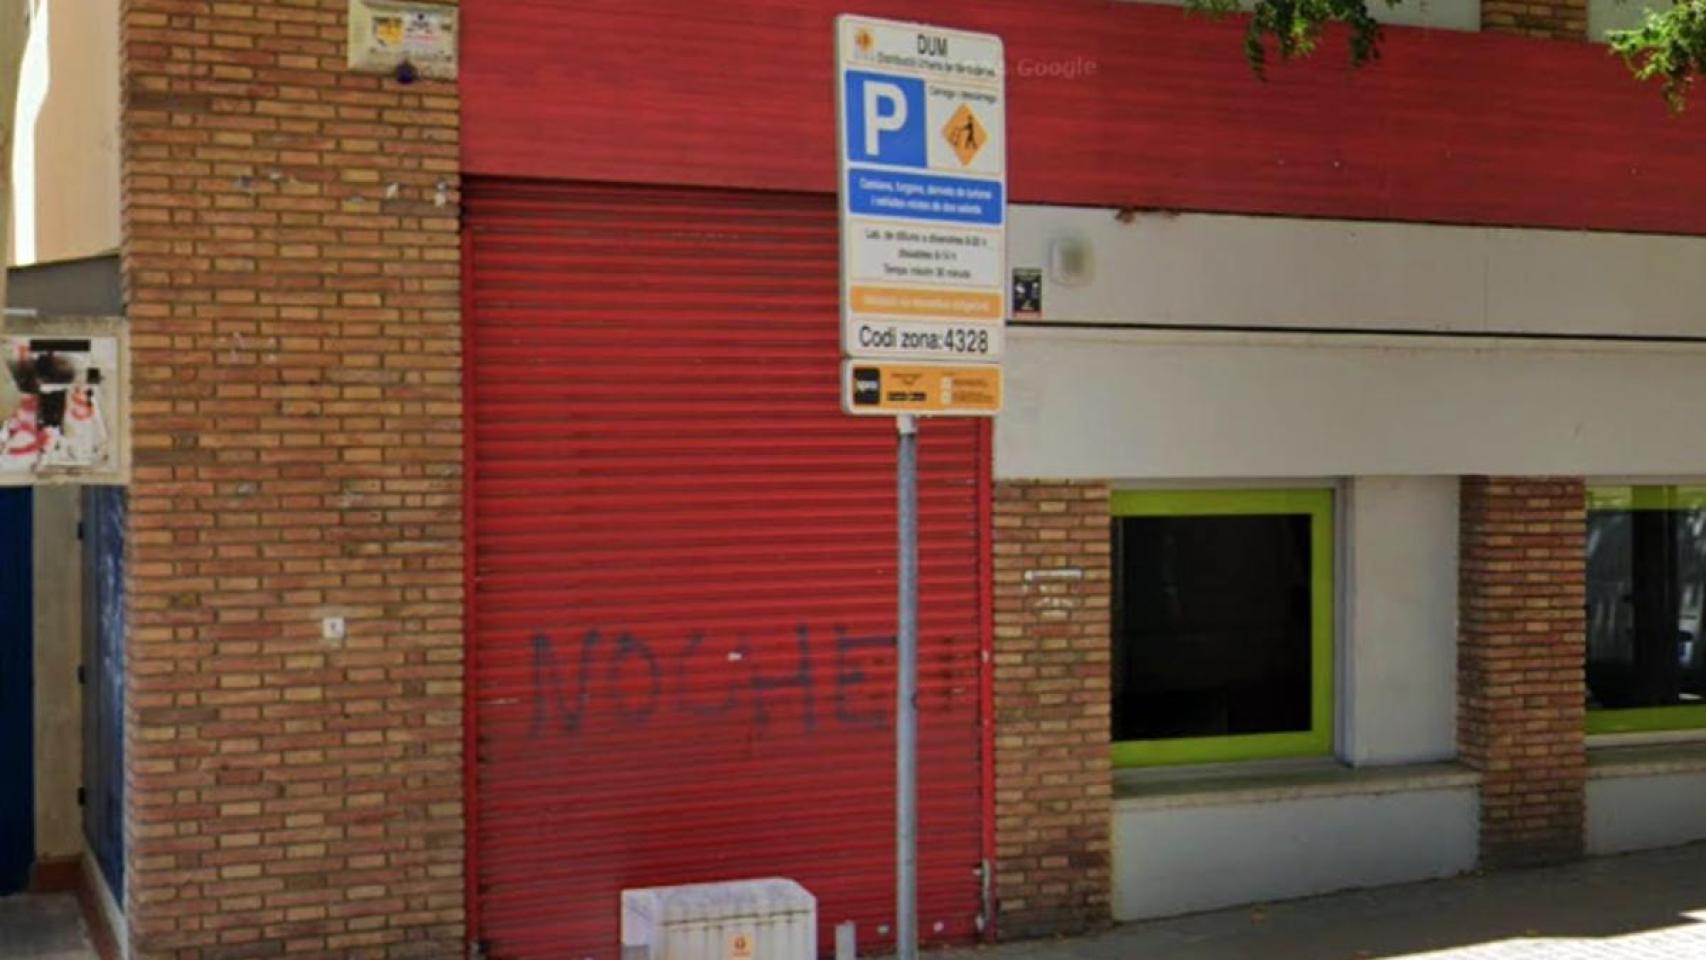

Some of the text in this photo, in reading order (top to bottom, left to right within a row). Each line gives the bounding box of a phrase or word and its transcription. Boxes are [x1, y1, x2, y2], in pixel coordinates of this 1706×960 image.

[917, 33, 948, 56] DUM
[863, 80, 908, 156] P
[859, 325, 897, 347] Codi
